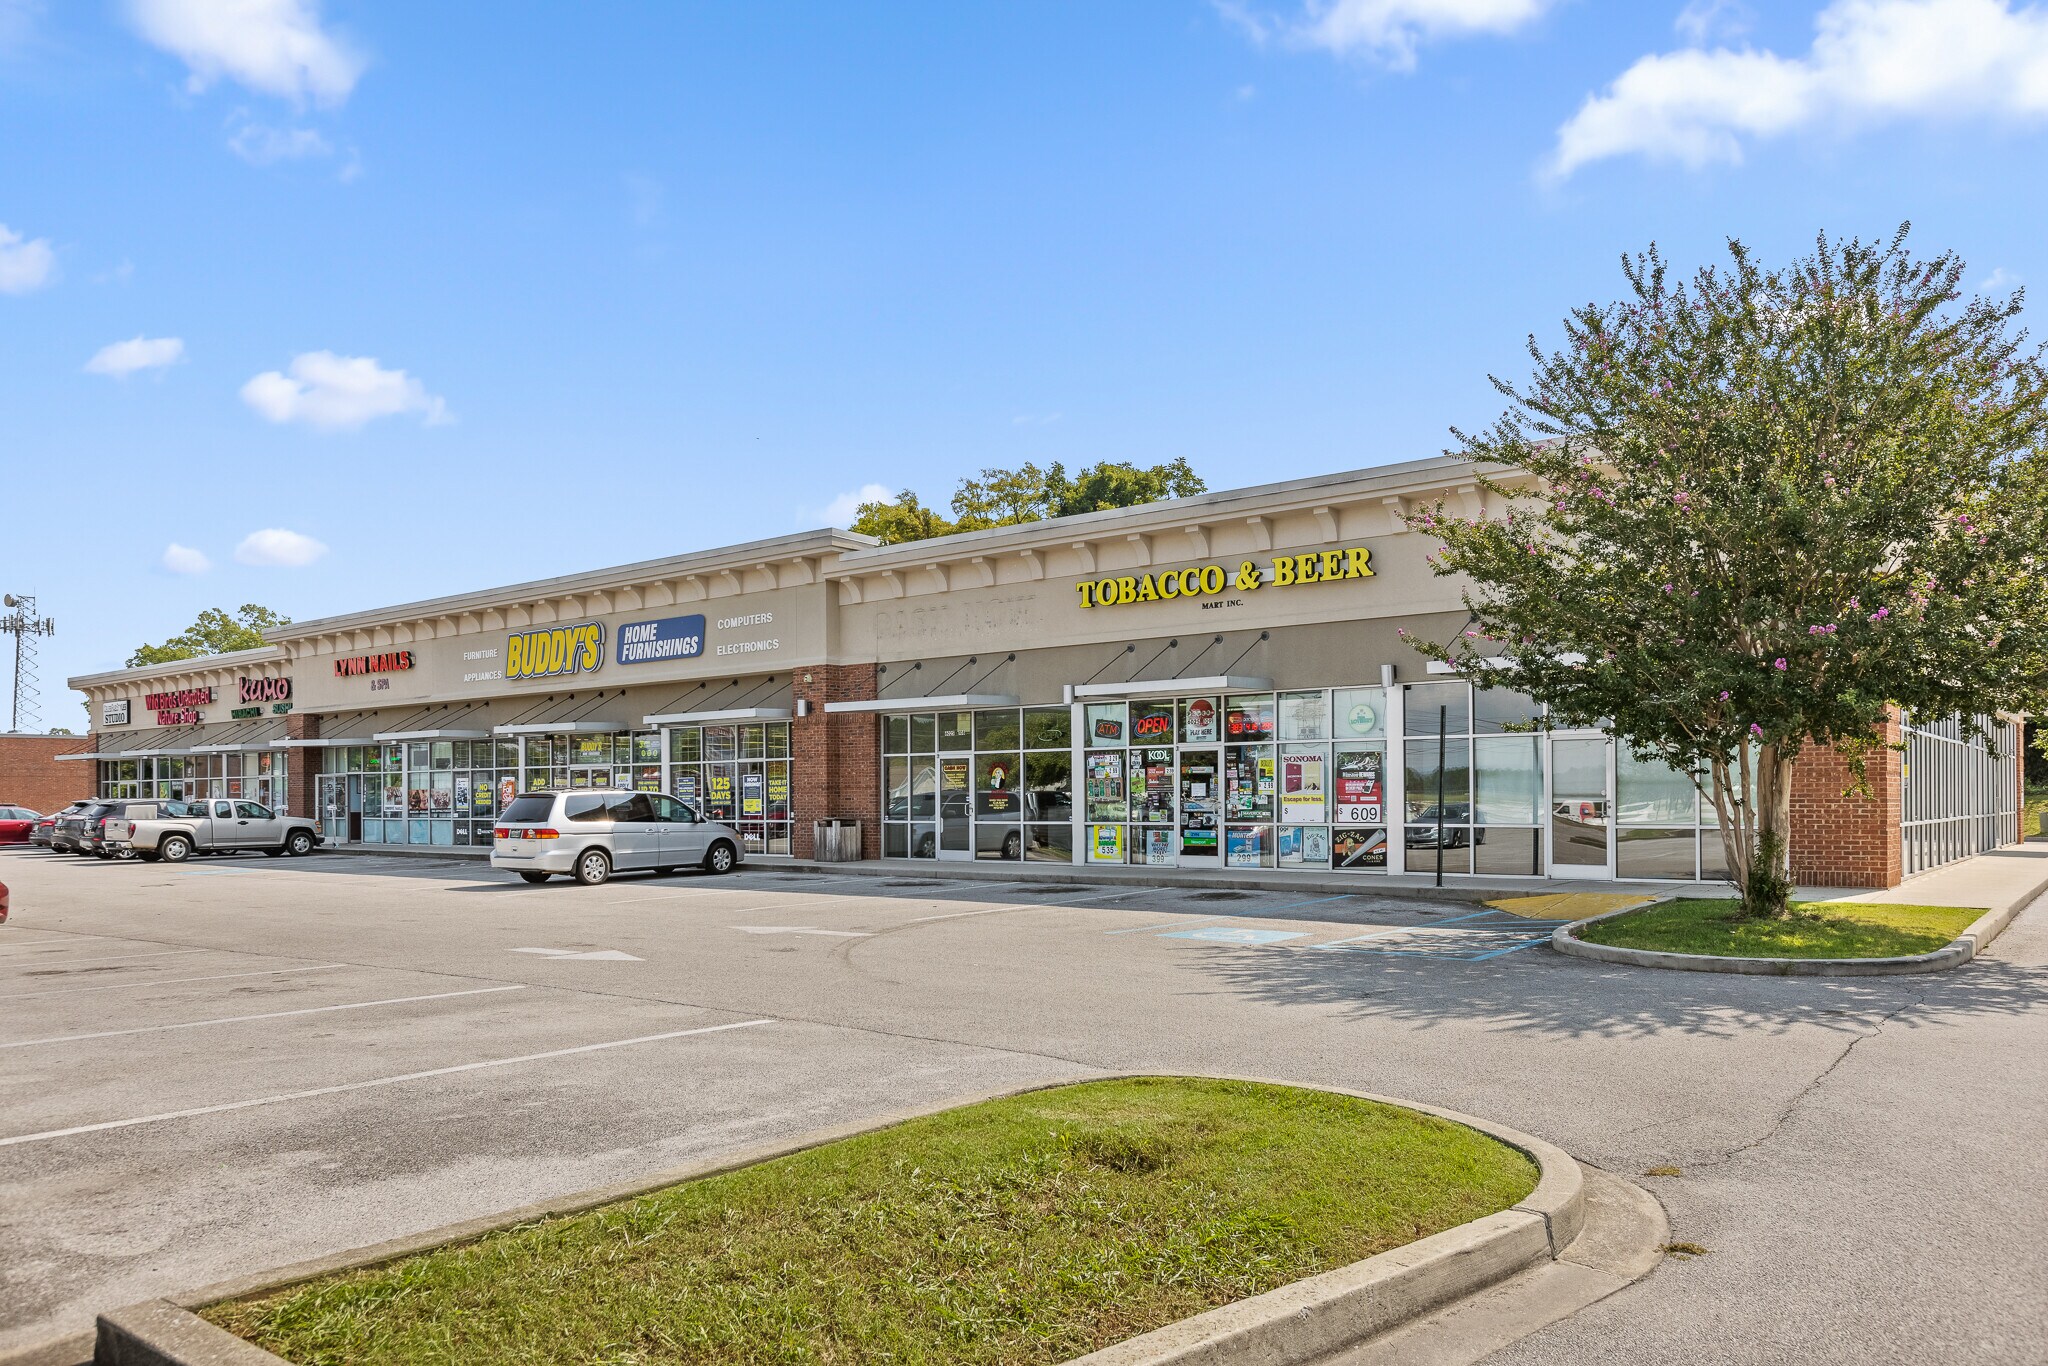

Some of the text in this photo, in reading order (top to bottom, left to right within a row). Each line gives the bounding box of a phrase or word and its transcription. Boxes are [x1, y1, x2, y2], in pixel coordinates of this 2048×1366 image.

[1076, 547, 1376, 608] TOBACCO & BEER
[1202, 601, 1223, 609] MART
[717, 612, 773, 630] COMPUTERS
[624, 623, 657, 644] HOME
[505, 622, 604, 679] BUDDY'S
[622, 636, 698, 661] FURNISHINGS
[717, 639, 779, 656] ELECTRONICS
[464, 649, 498, 660] FURNITURE
[333, 651, 410, 677] LYNN NAILS
[464, 671, 502, 682] APPLIANCES
[371, 678, 390, 691] & SPA
[105, 713, 125, 724] STUDIO
[158, 710, 178, 725] Nature
[1098, 724, 1117, 734] ATM
[1137, 717, 1168, 734] OPEN
[1148, 750, 1170, 760] KOOL
[1283, 755, 1323, 763] SONOMA
[479, 783, 488, 791] NO
[533, 778, 546, 786] ADD
[711, 777, 731, 790] 125
[711, 791, 731, 800] DAYS
[744, 833, 760, 841] DELL
[1335, 831, 1365, 843] ZIG-ZAG
